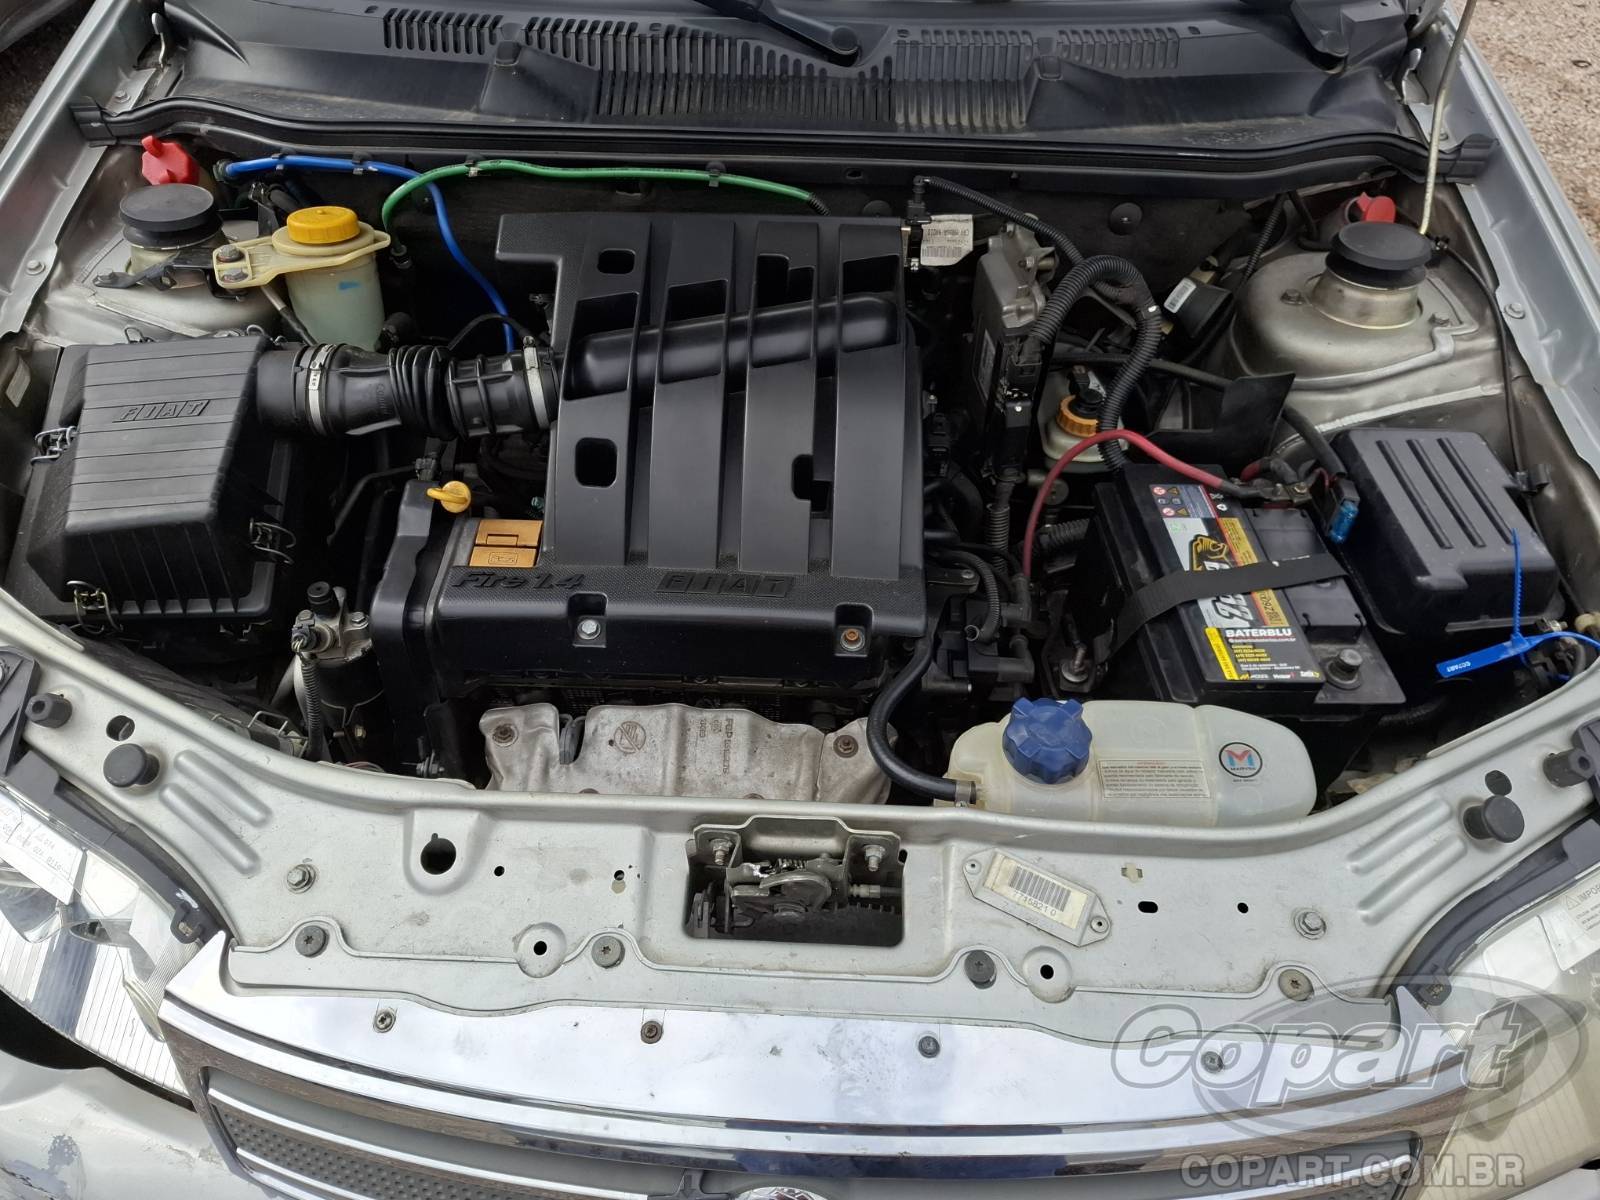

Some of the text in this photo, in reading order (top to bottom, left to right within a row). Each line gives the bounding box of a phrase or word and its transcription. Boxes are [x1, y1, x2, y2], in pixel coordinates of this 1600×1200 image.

[118, 401, 206, 421] FIAT
[452, 571, 586, 591] Fire 1.4
[657, 571, 796, 598] FIAT
[1225, 628, 1293, 638] BATERBLU
